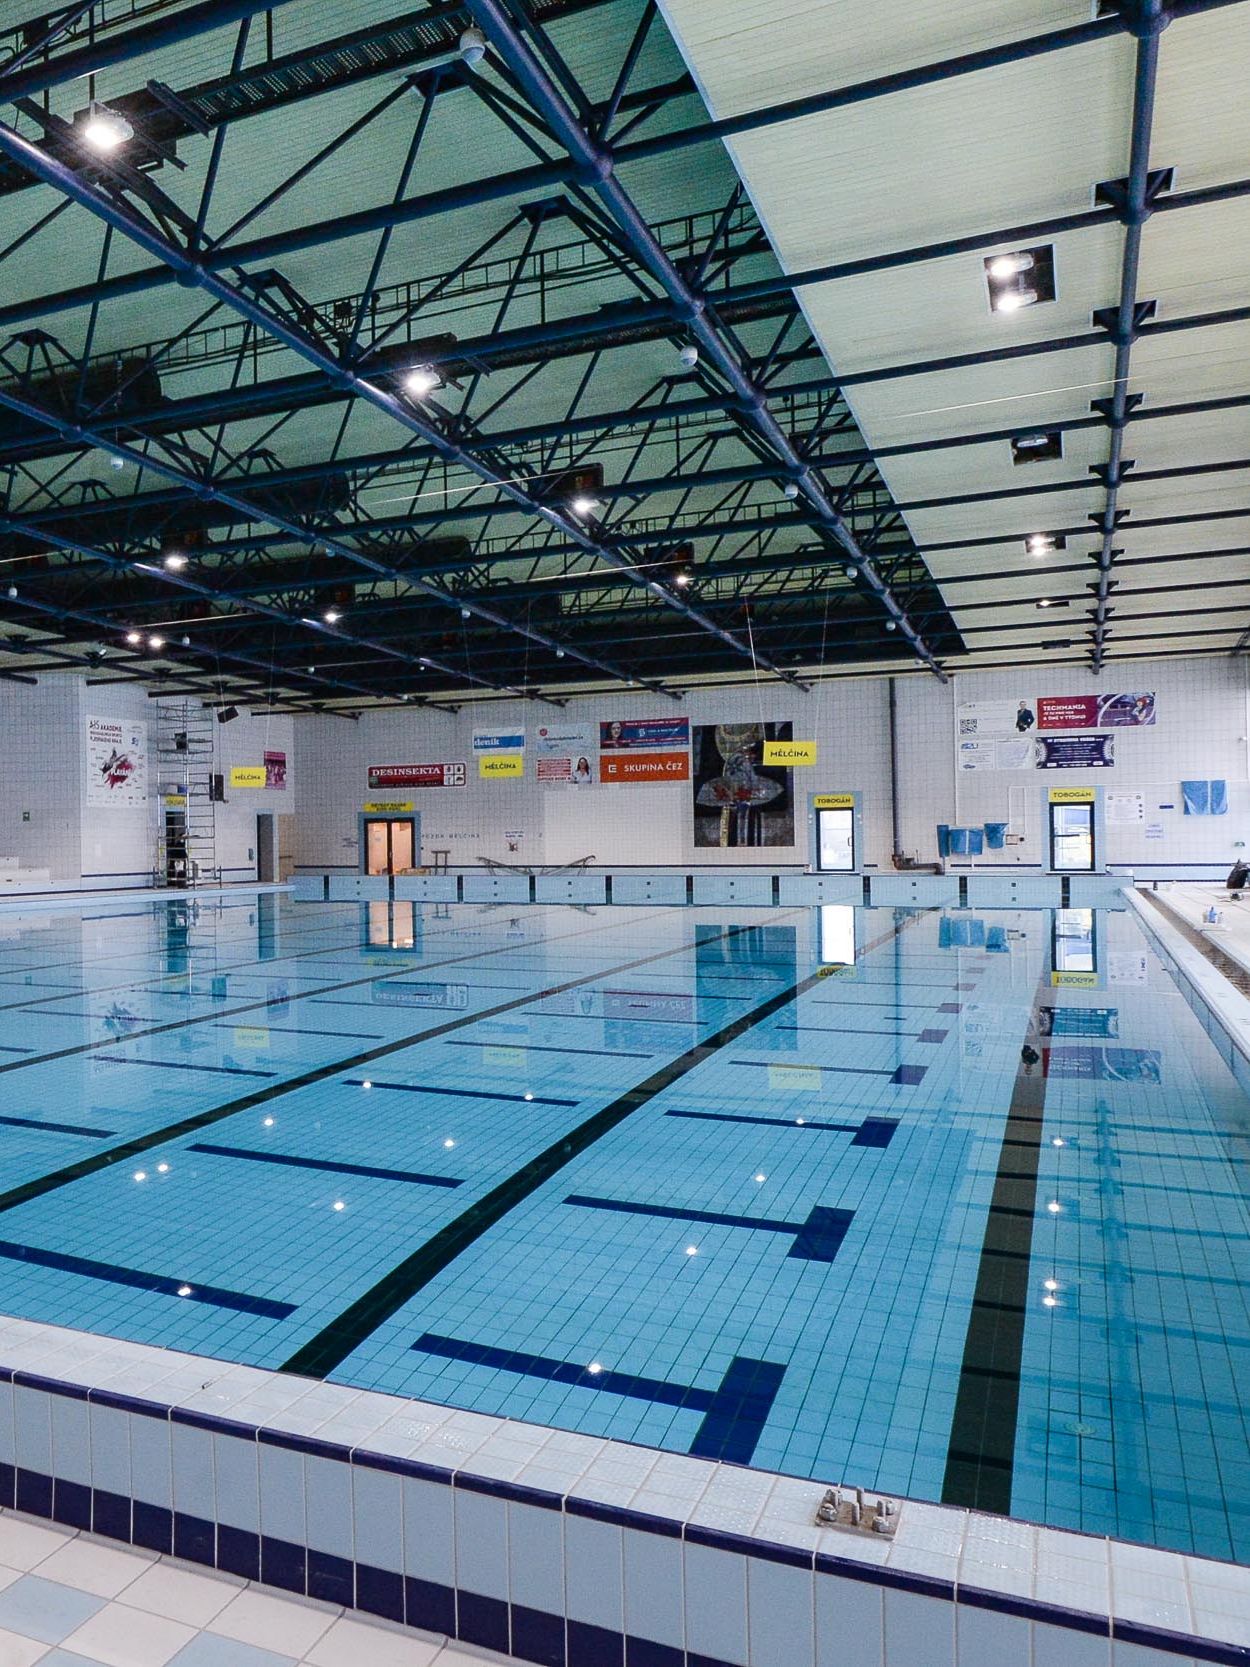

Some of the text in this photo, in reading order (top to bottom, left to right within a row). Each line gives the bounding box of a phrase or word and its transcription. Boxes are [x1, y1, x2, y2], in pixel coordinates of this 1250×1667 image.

[770, 749, 809, 757] MĚLČINA
[624, 761, 683, 772] SKUPINA ČEZ
[372, 767, 441, 776] DESINSEKTA
